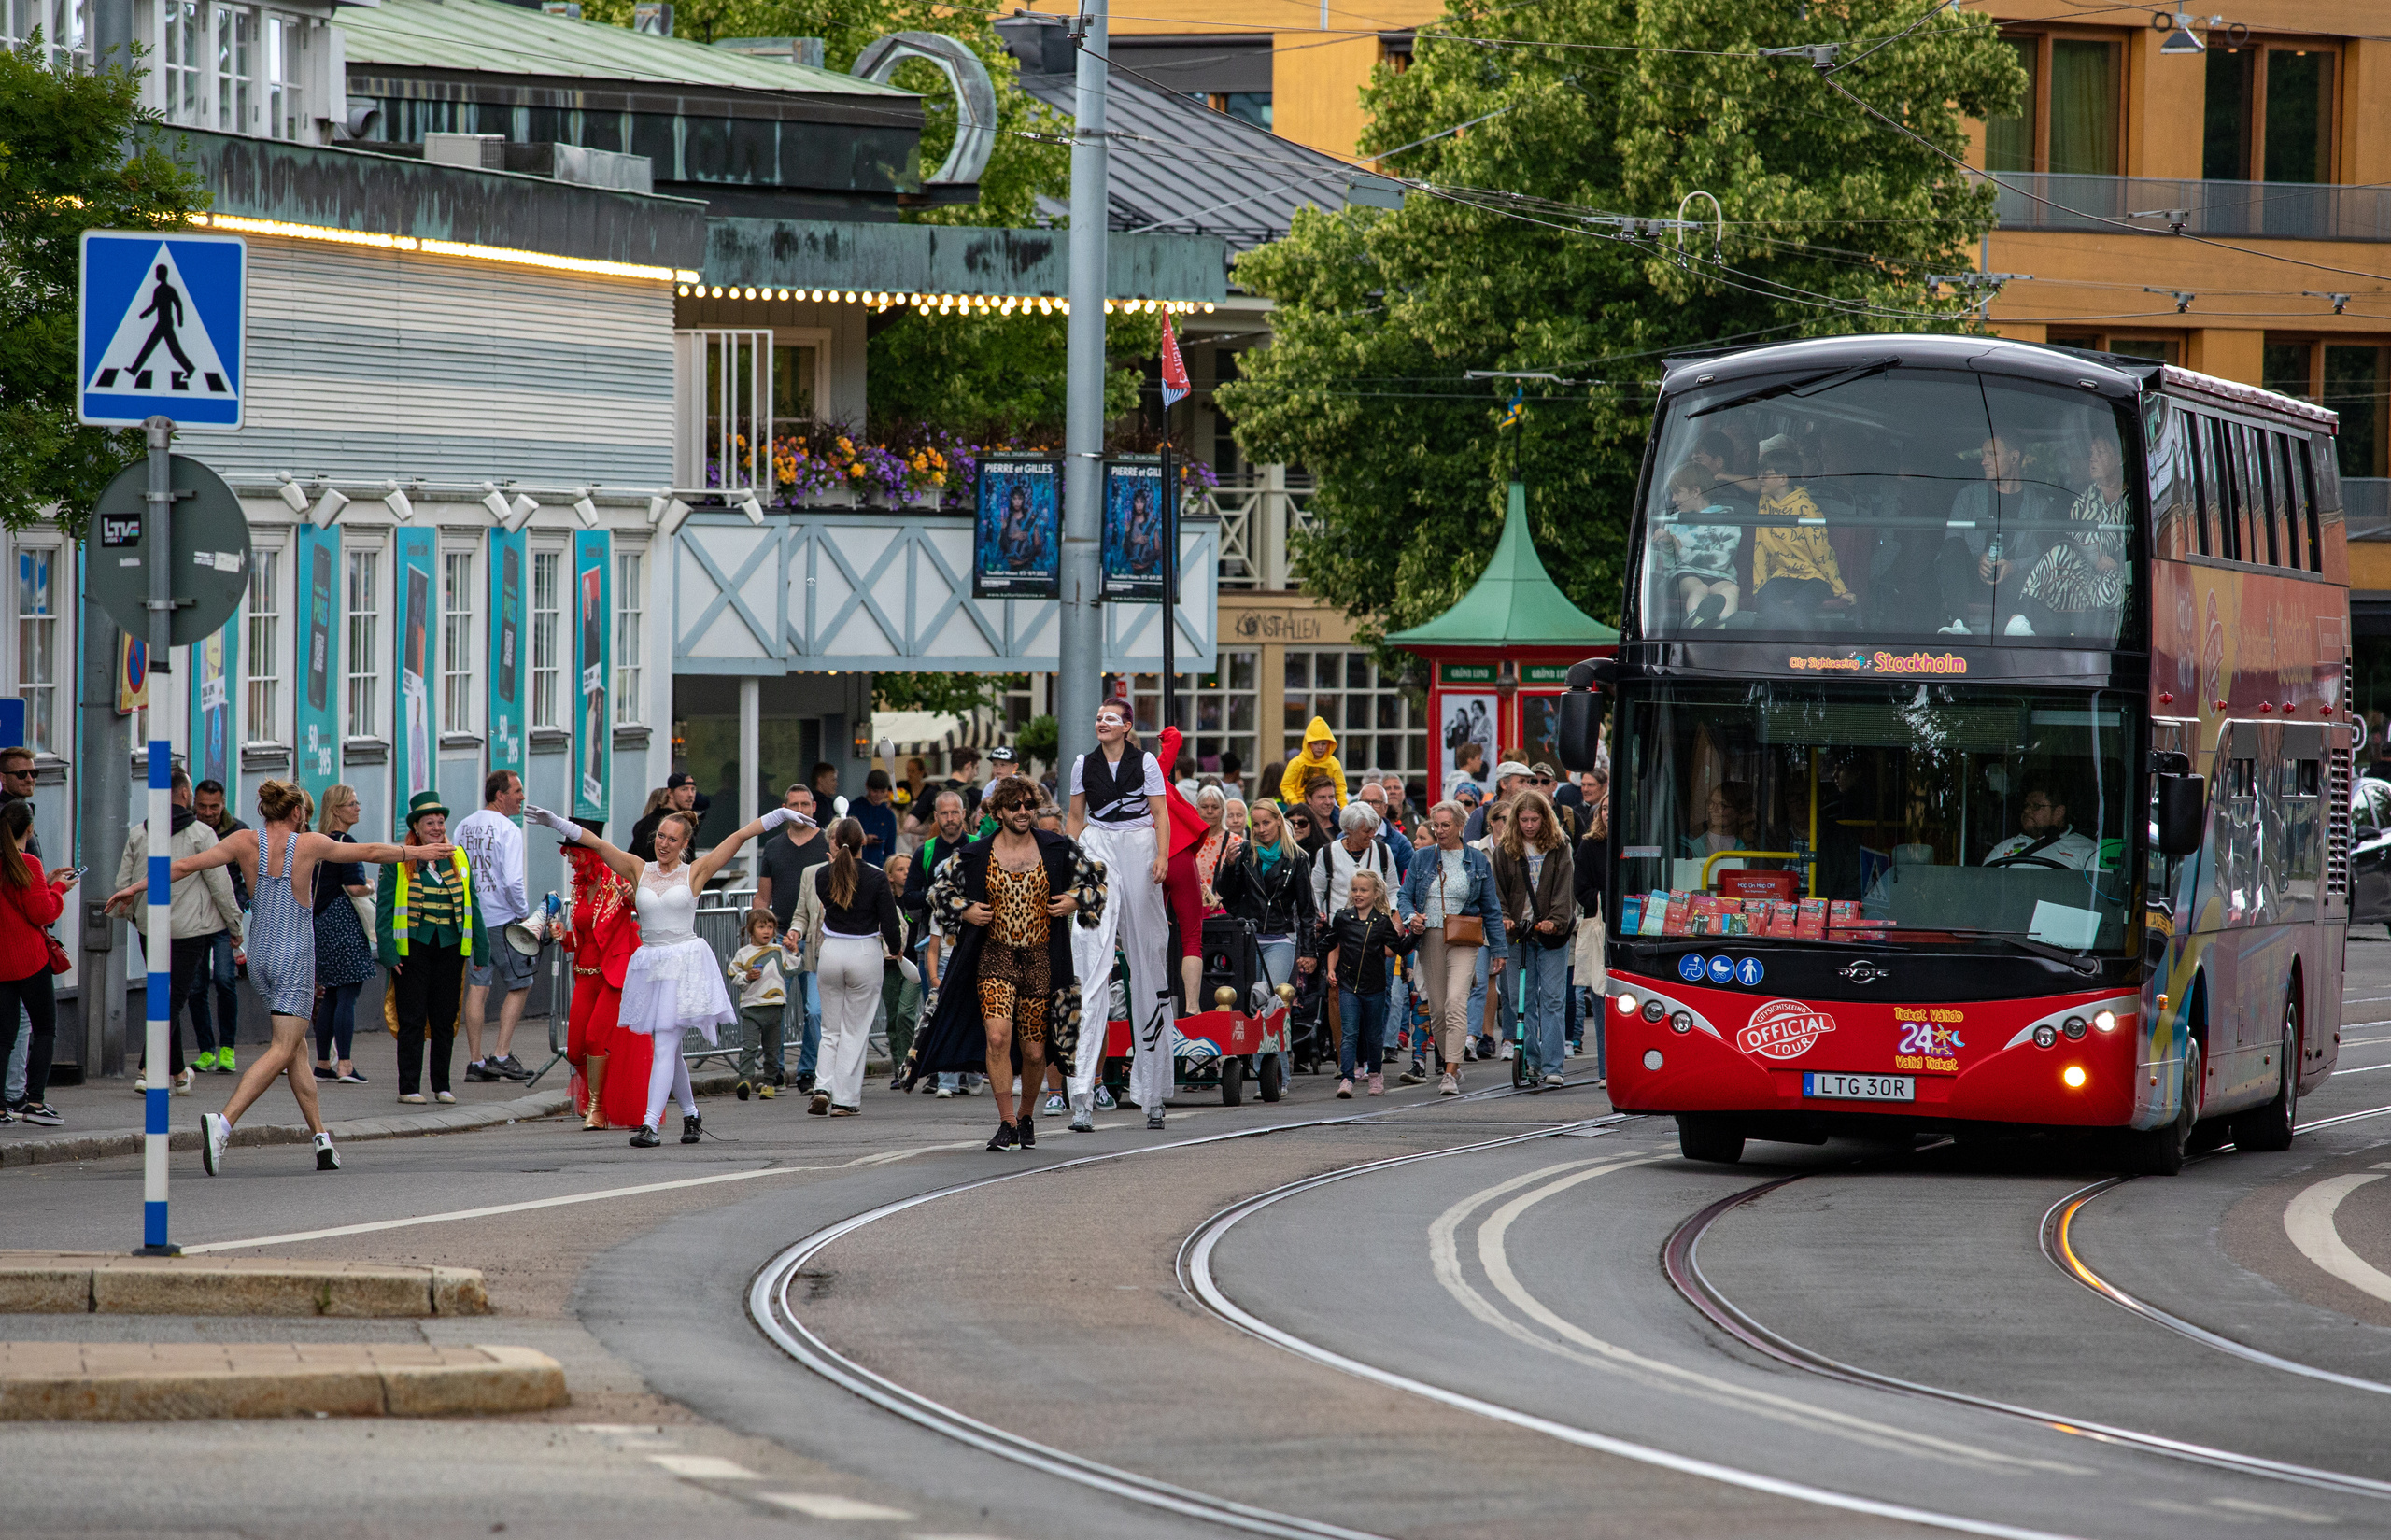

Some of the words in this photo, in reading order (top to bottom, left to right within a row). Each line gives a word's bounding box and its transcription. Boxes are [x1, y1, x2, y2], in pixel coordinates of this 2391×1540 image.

[984, 463, 1014, 473] PIERRE
[1015, 465, 1023, 473] et
[1024, 464, 1054, 474] GILLES
[1111, 466, 1139, 476] PIERRE
[1139, 468, 1146, 477] et
[1790, 657, 1806, 669] City
[1807, 657, 1860, 670] Sightseeing
[1875, 652, 1967, 673] Stockholm
[500, 714, 508, 742] 50
[308, 724, 318, 753] 50
[507, 737, 519, 764] 395
[318, 747, 332, 776] 395
[461, 825, 484, 835] Tears
[466, 836, 484, 851] For
[1756, 1003, 1806, 1023] CITYSIGHTSEEING
[1894, 1007, 1928, 1022] Ticket
[1930, 1009, 1964, 1023] Válido
[1747, 1016, 1830, 1047] OFFICIAL
[1900, 1023, 1933, 1053] 24
[1775, 1037, 1811, 1054] TOUR
[1895, 1055, 1923, 1069] Valid
[1925, 1056, 1959, 1071] Ticket
[1822, 1076, 1860, 1095] LTG
[1867, 1078, 1904, 1097] 30R
